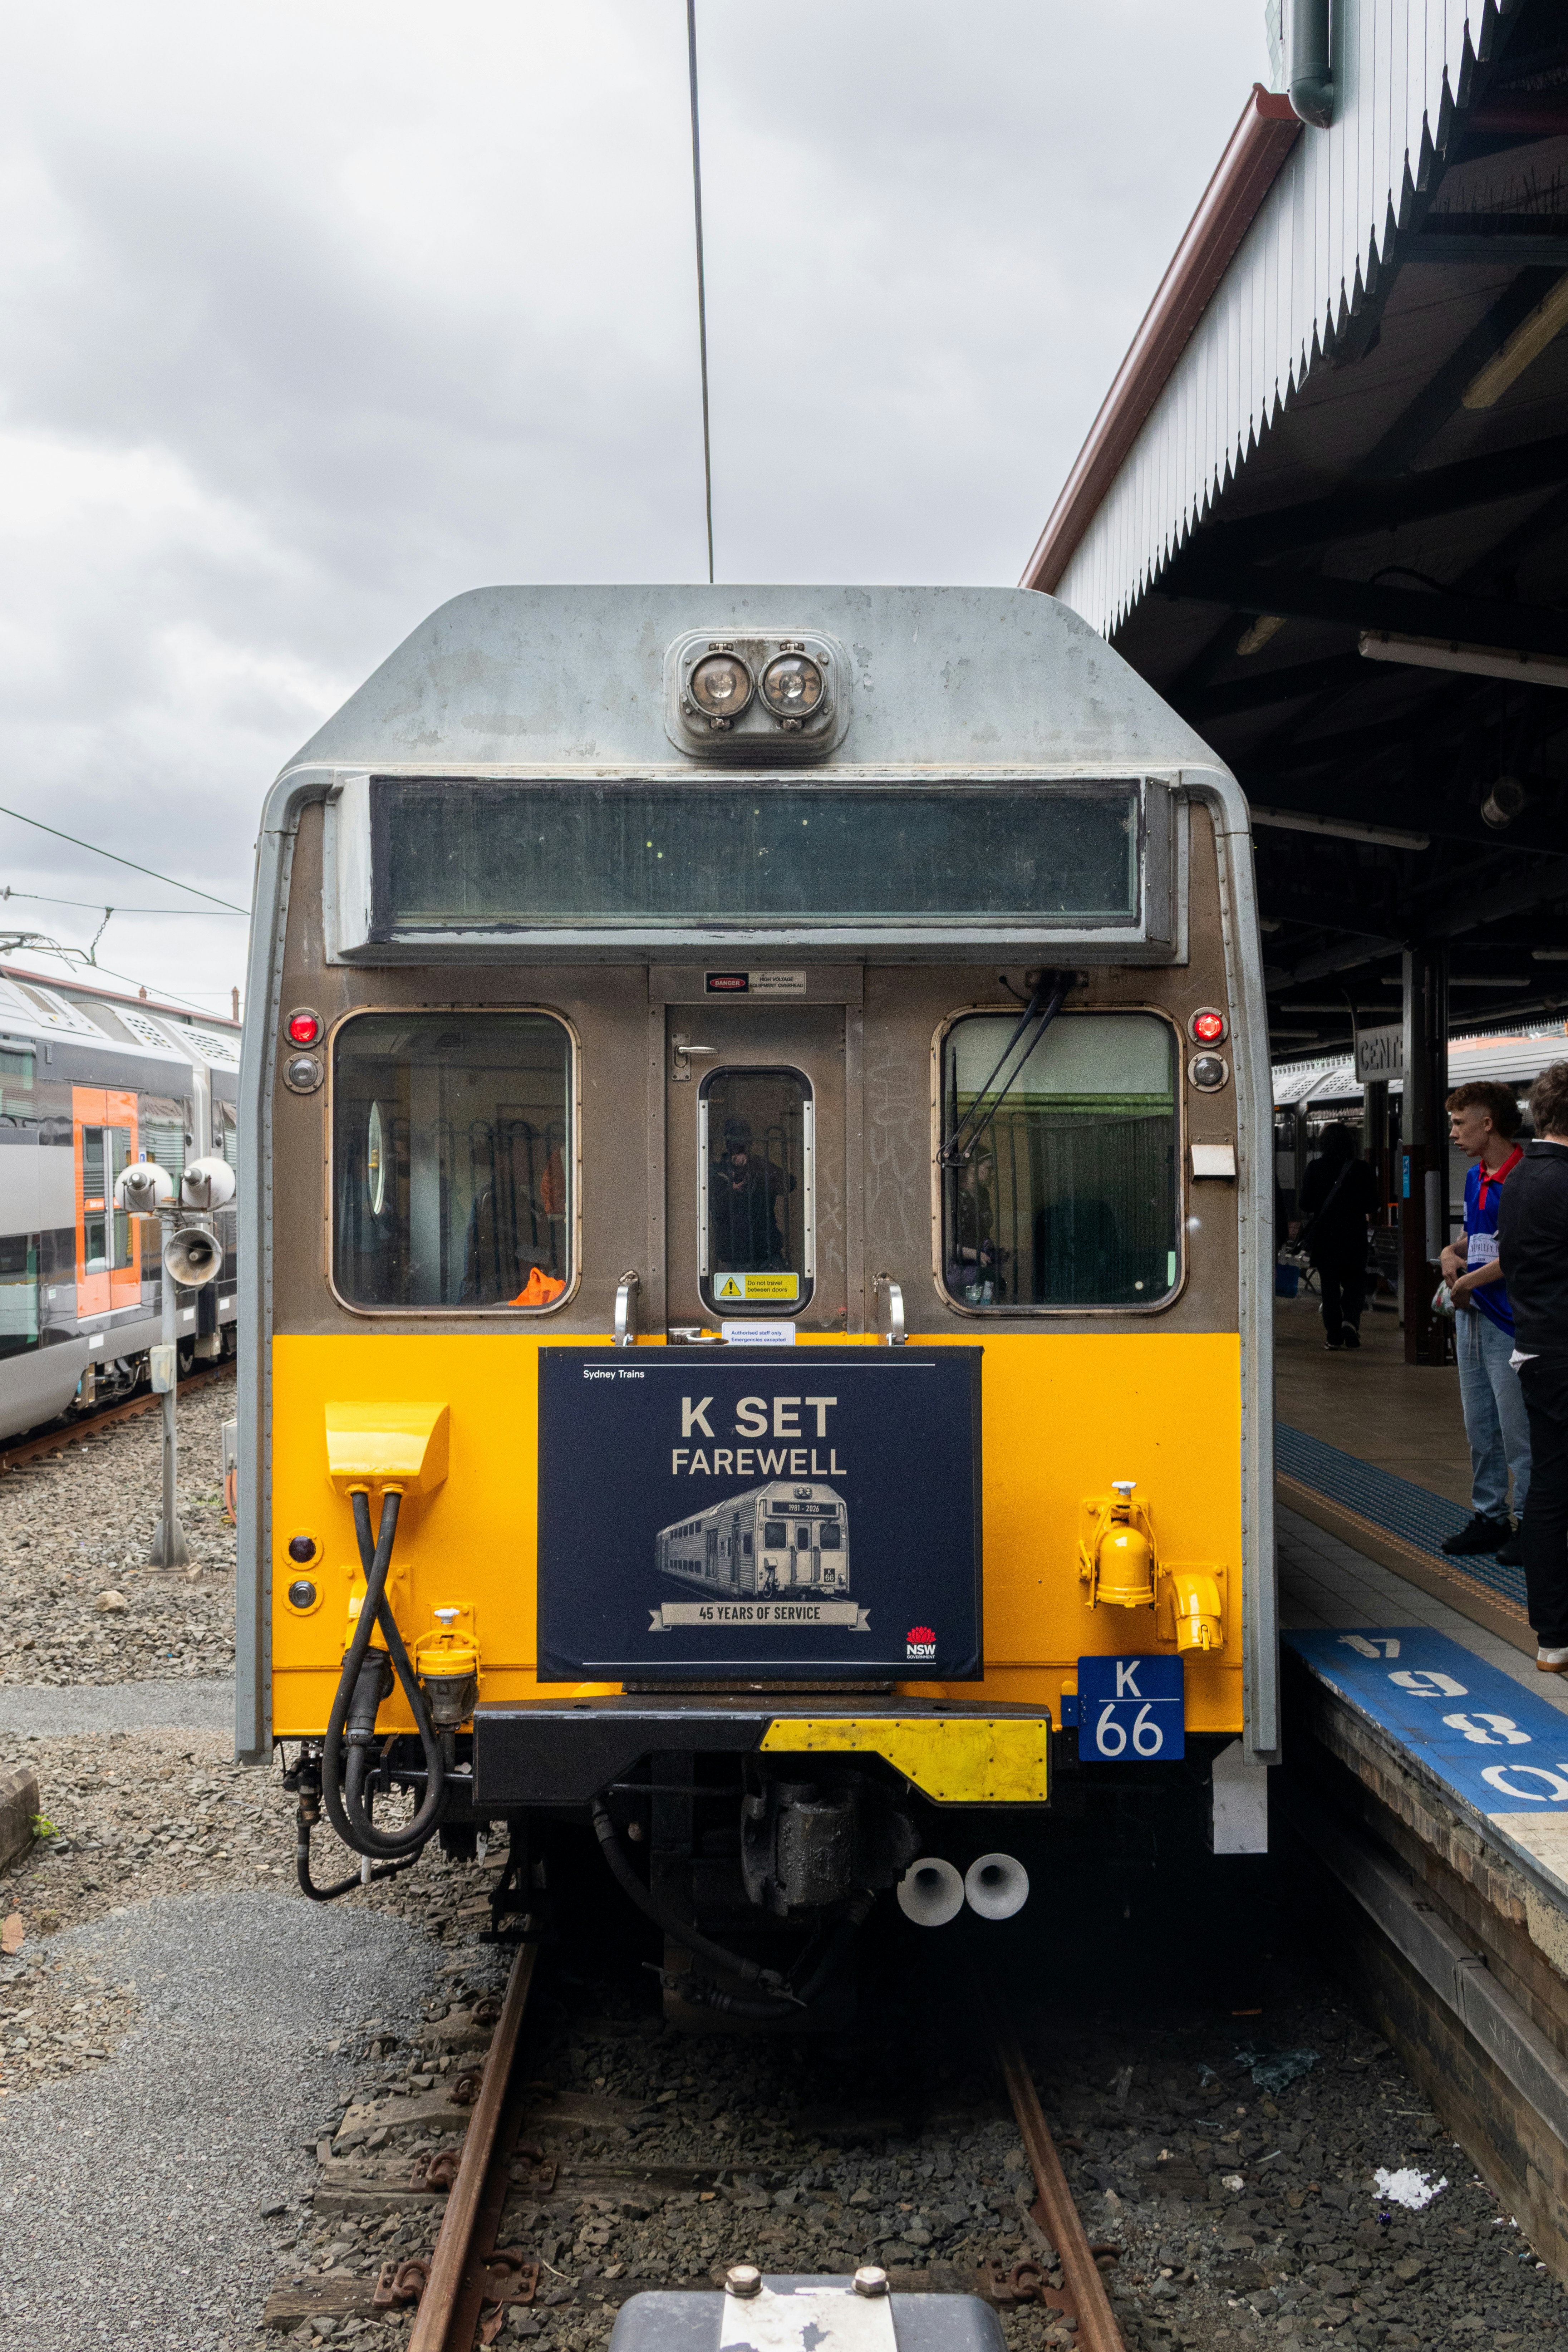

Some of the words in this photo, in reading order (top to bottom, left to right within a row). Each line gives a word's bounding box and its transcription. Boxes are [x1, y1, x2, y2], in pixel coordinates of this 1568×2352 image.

[583, 1370, 616, 1380] Sydney
[618, 1370, 645, 1378] Trains
[682, 1397, 715, 1437] K
[735, 1396, 837, 1438] SET
[672, 1449, 847, 1474] FAREWELL
[699, 1607, 713, 1620] 45
[717, 1607, 753, 1620] YEARS
[757, 1607, 771, 1620] OF
[774, 1607, 821, 1620] SERVICE
[907, 1645, 936, 1655] NSW
[1116, 1661, 1142, 1697] K
[1096, 1703, 1163, 1757] 66
[1442, 1713, 1532, 1745] 8
